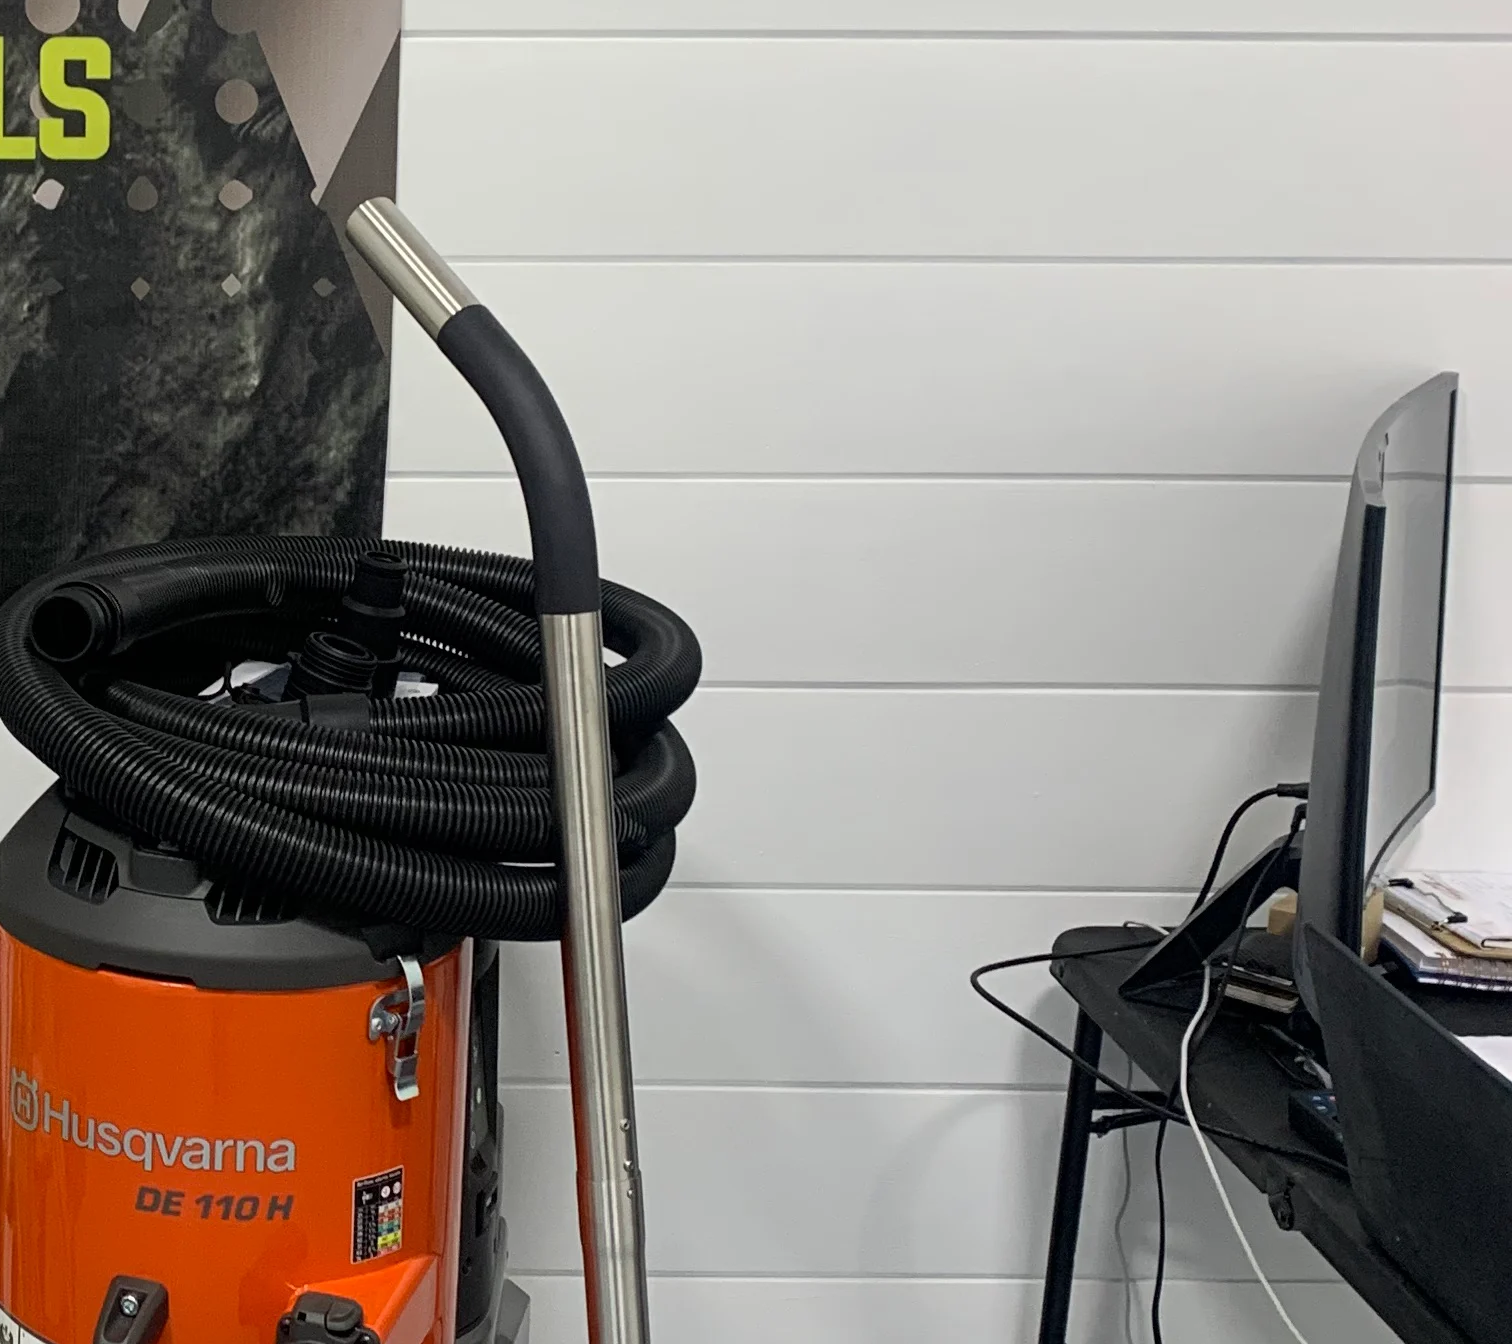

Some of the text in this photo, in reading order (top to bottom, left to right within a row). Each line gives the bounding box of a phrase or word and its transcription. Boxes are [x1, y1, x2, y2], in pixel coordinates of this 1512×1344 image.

[43, 1091, 296, 1173] Husqvarna
[135, 1186, 294, 1222] DE 110 H
